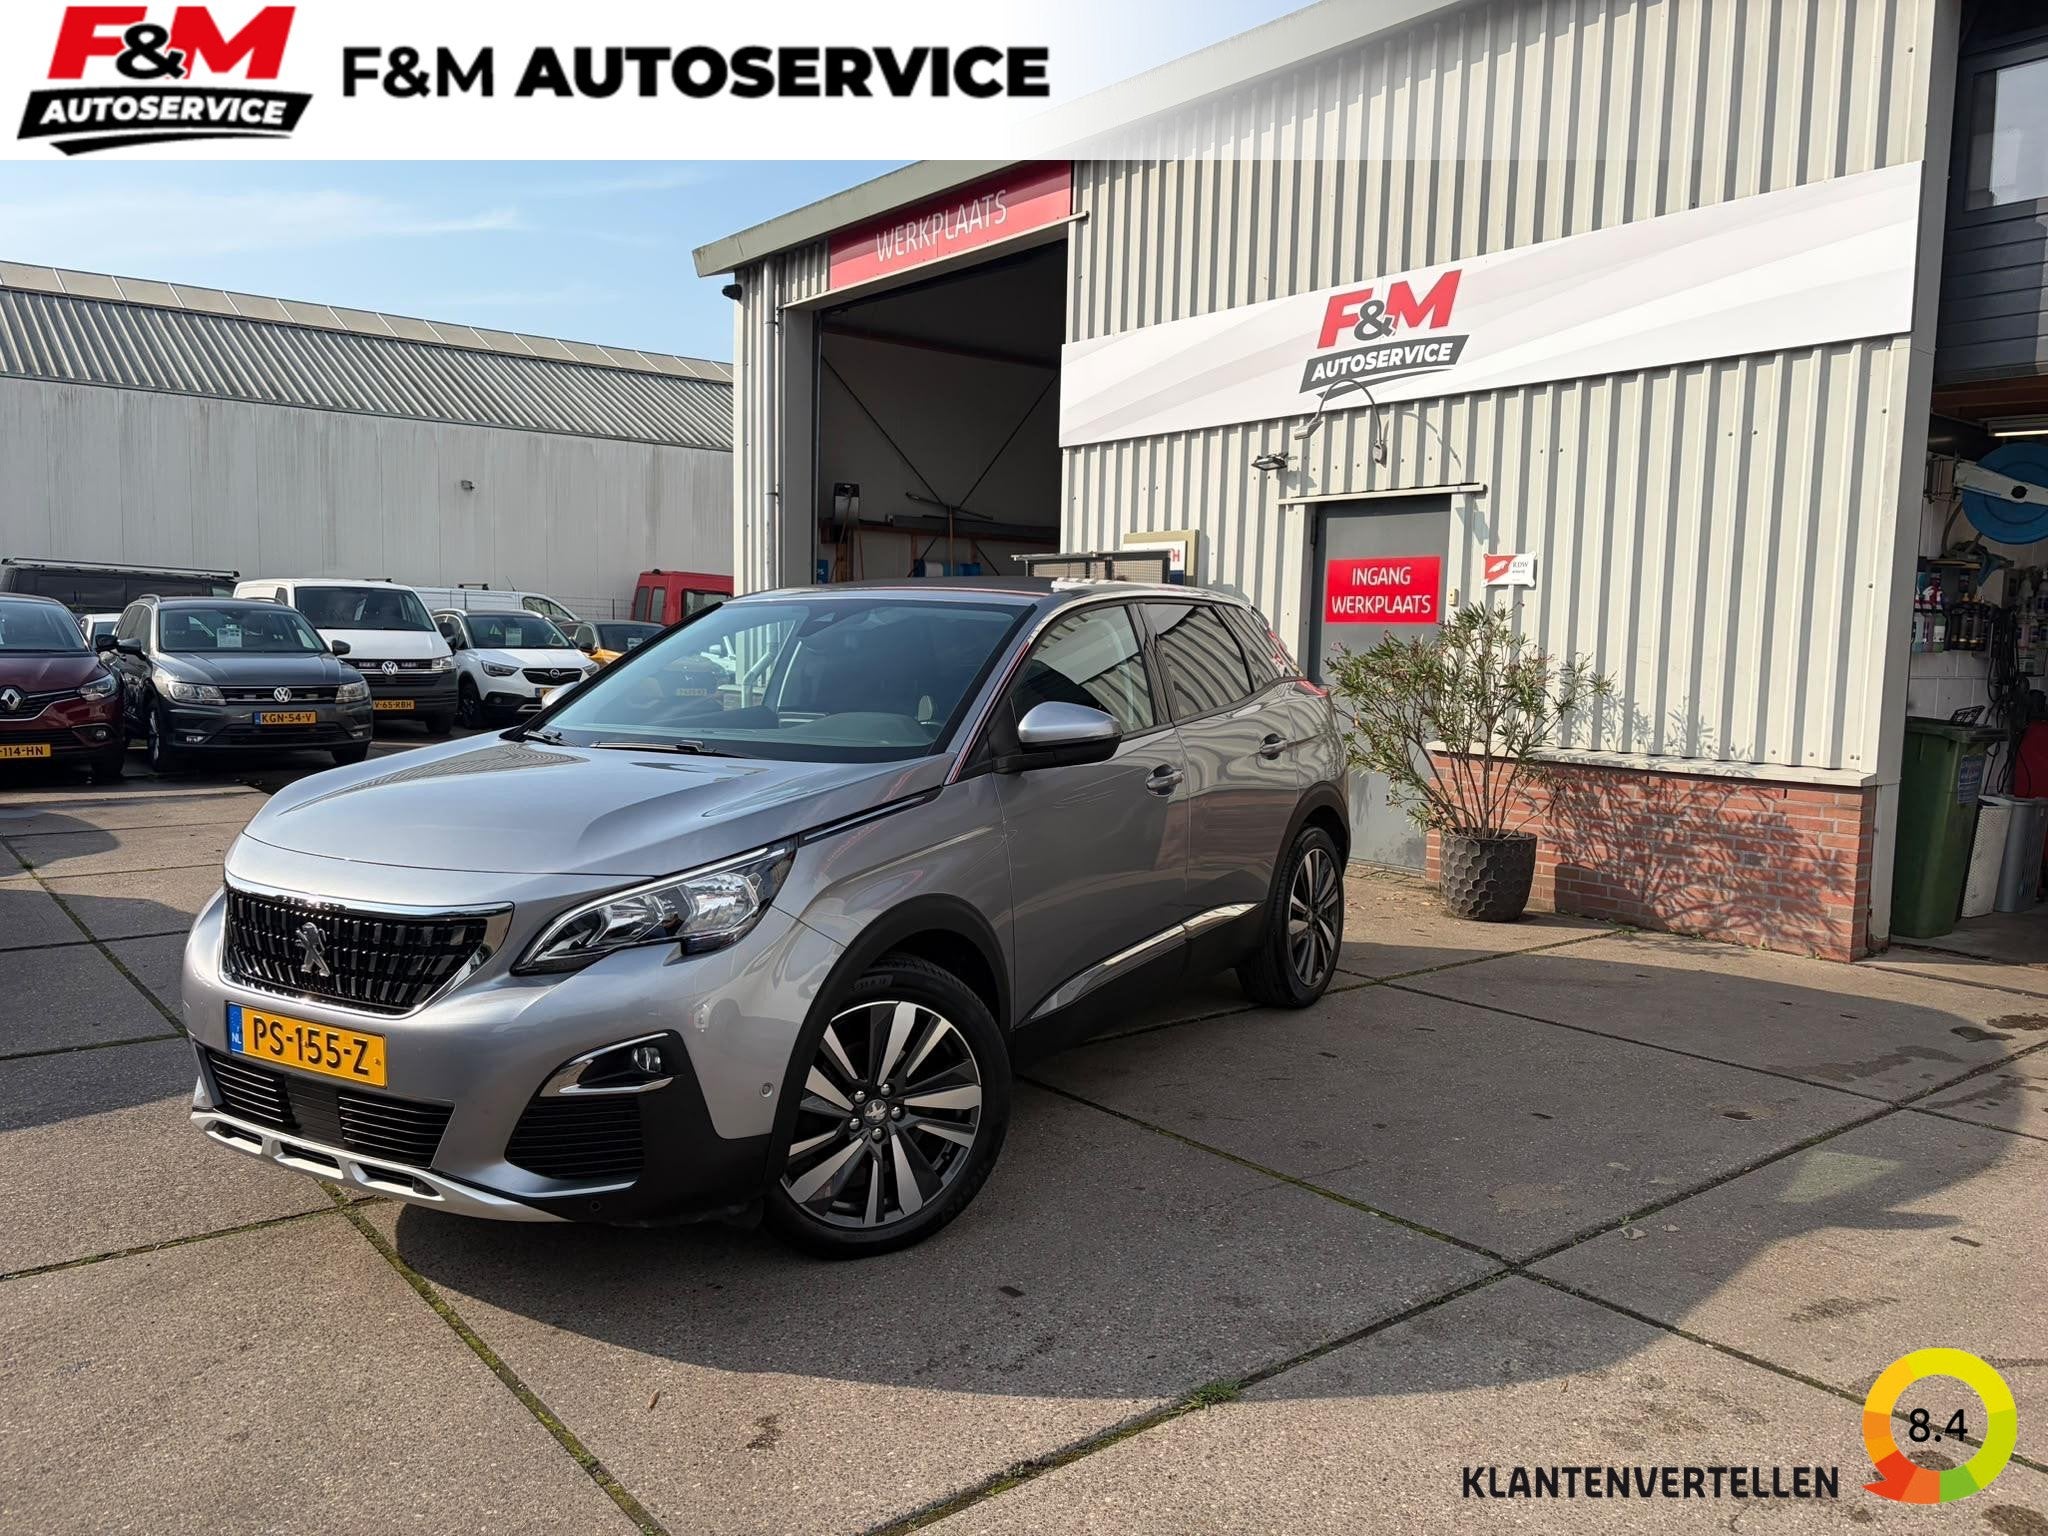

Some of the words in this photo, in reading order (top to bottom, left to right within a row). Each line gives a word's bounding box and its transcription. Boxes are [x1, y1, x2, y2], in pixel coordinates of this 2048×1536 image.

[876, 188, 1008, 263] WERKPLAATS
[1317, 269, 1462, 349] F&M
[1310, 342, 1454, 382] AUTOSERVICE
[1351, 566, 1412, 586] INGANG
[1331, 595, 1432, 614] WERKPLAATS
[253, 1016, 369, 1076] PS-155-Z
